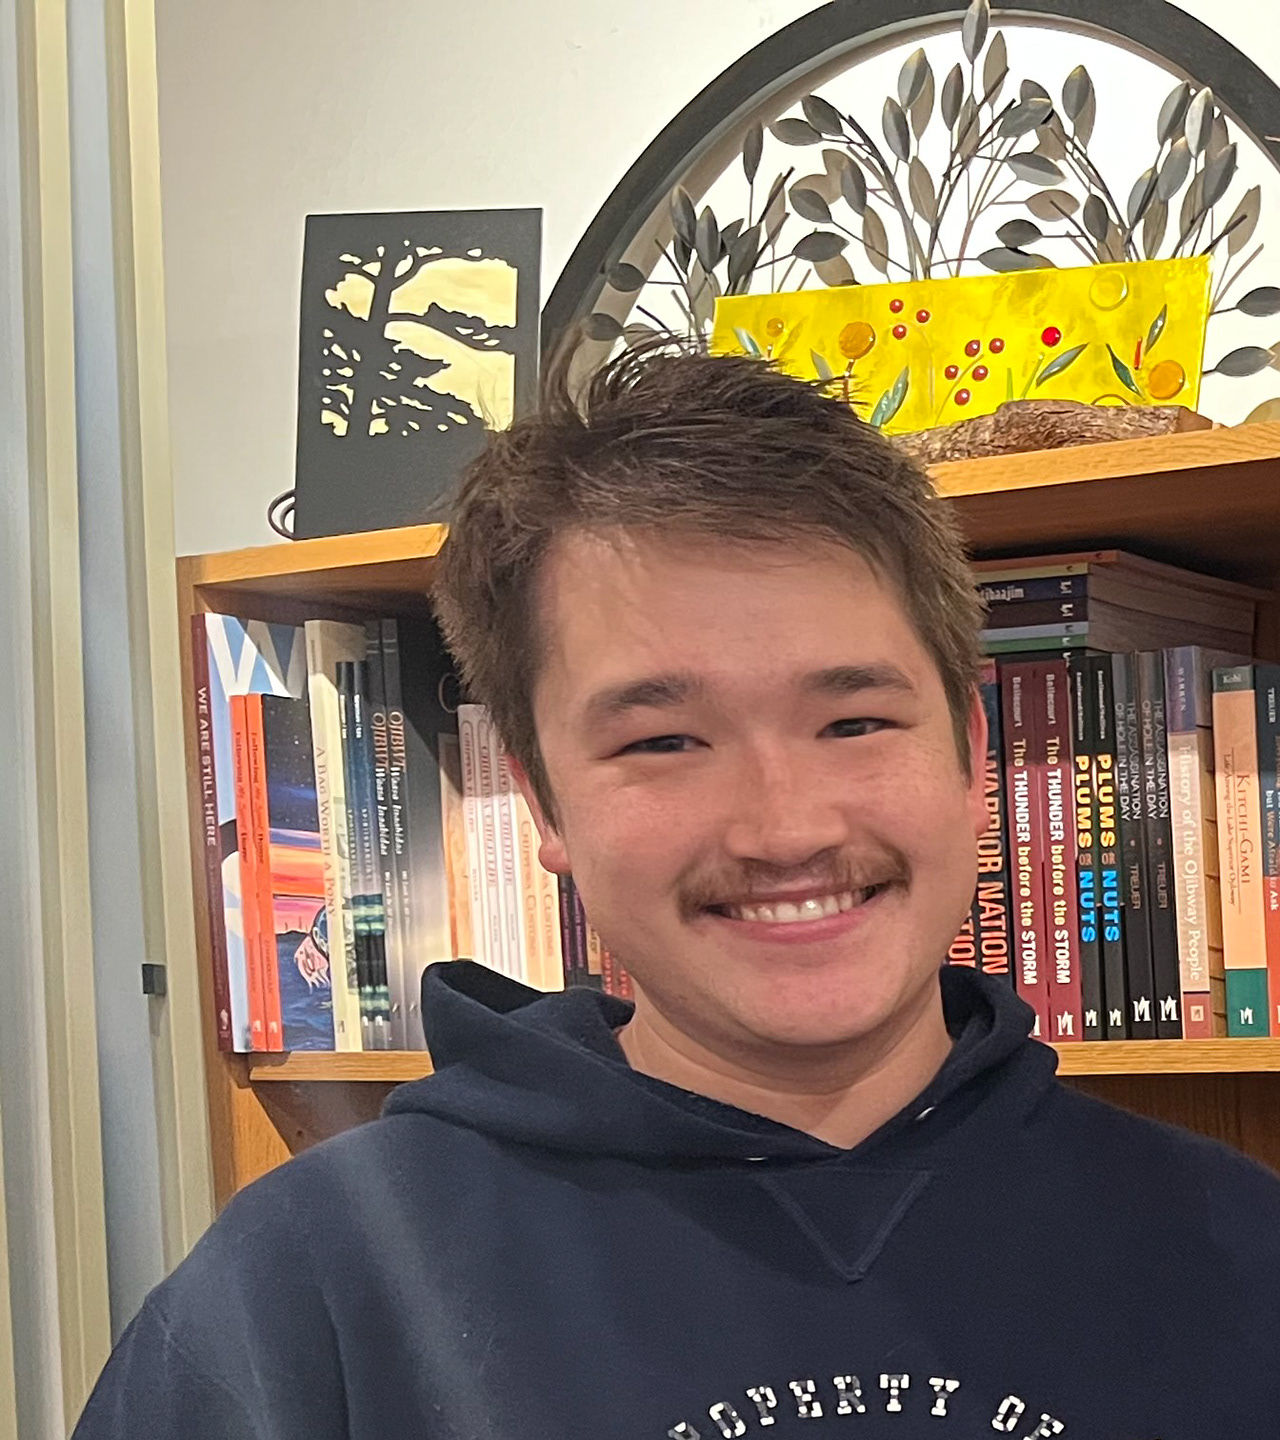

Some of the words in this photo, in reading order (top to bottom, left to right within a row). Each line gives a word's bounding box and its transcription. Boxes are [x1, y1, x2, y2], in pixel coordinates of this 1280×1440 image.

[197, 687, 209, 715] WE
[199, 719, 211, 751] ARE
[1046, 736, 1060, 765] The
[201, 754, 214, 802] STILL
[1047, 768, 1064, 841] THUNDER
[1097, 754, 1116, 848] PLUMS
[203, 803, 216, 846] HERE
[1050, 845, 1065, 896] before
[1101, 852, 1116, 866] OR
[1054, 898, 1066, 926] the
[1102, 870, 1120, 942] NUTS
[1054, 929, 1071, 985] STORM
